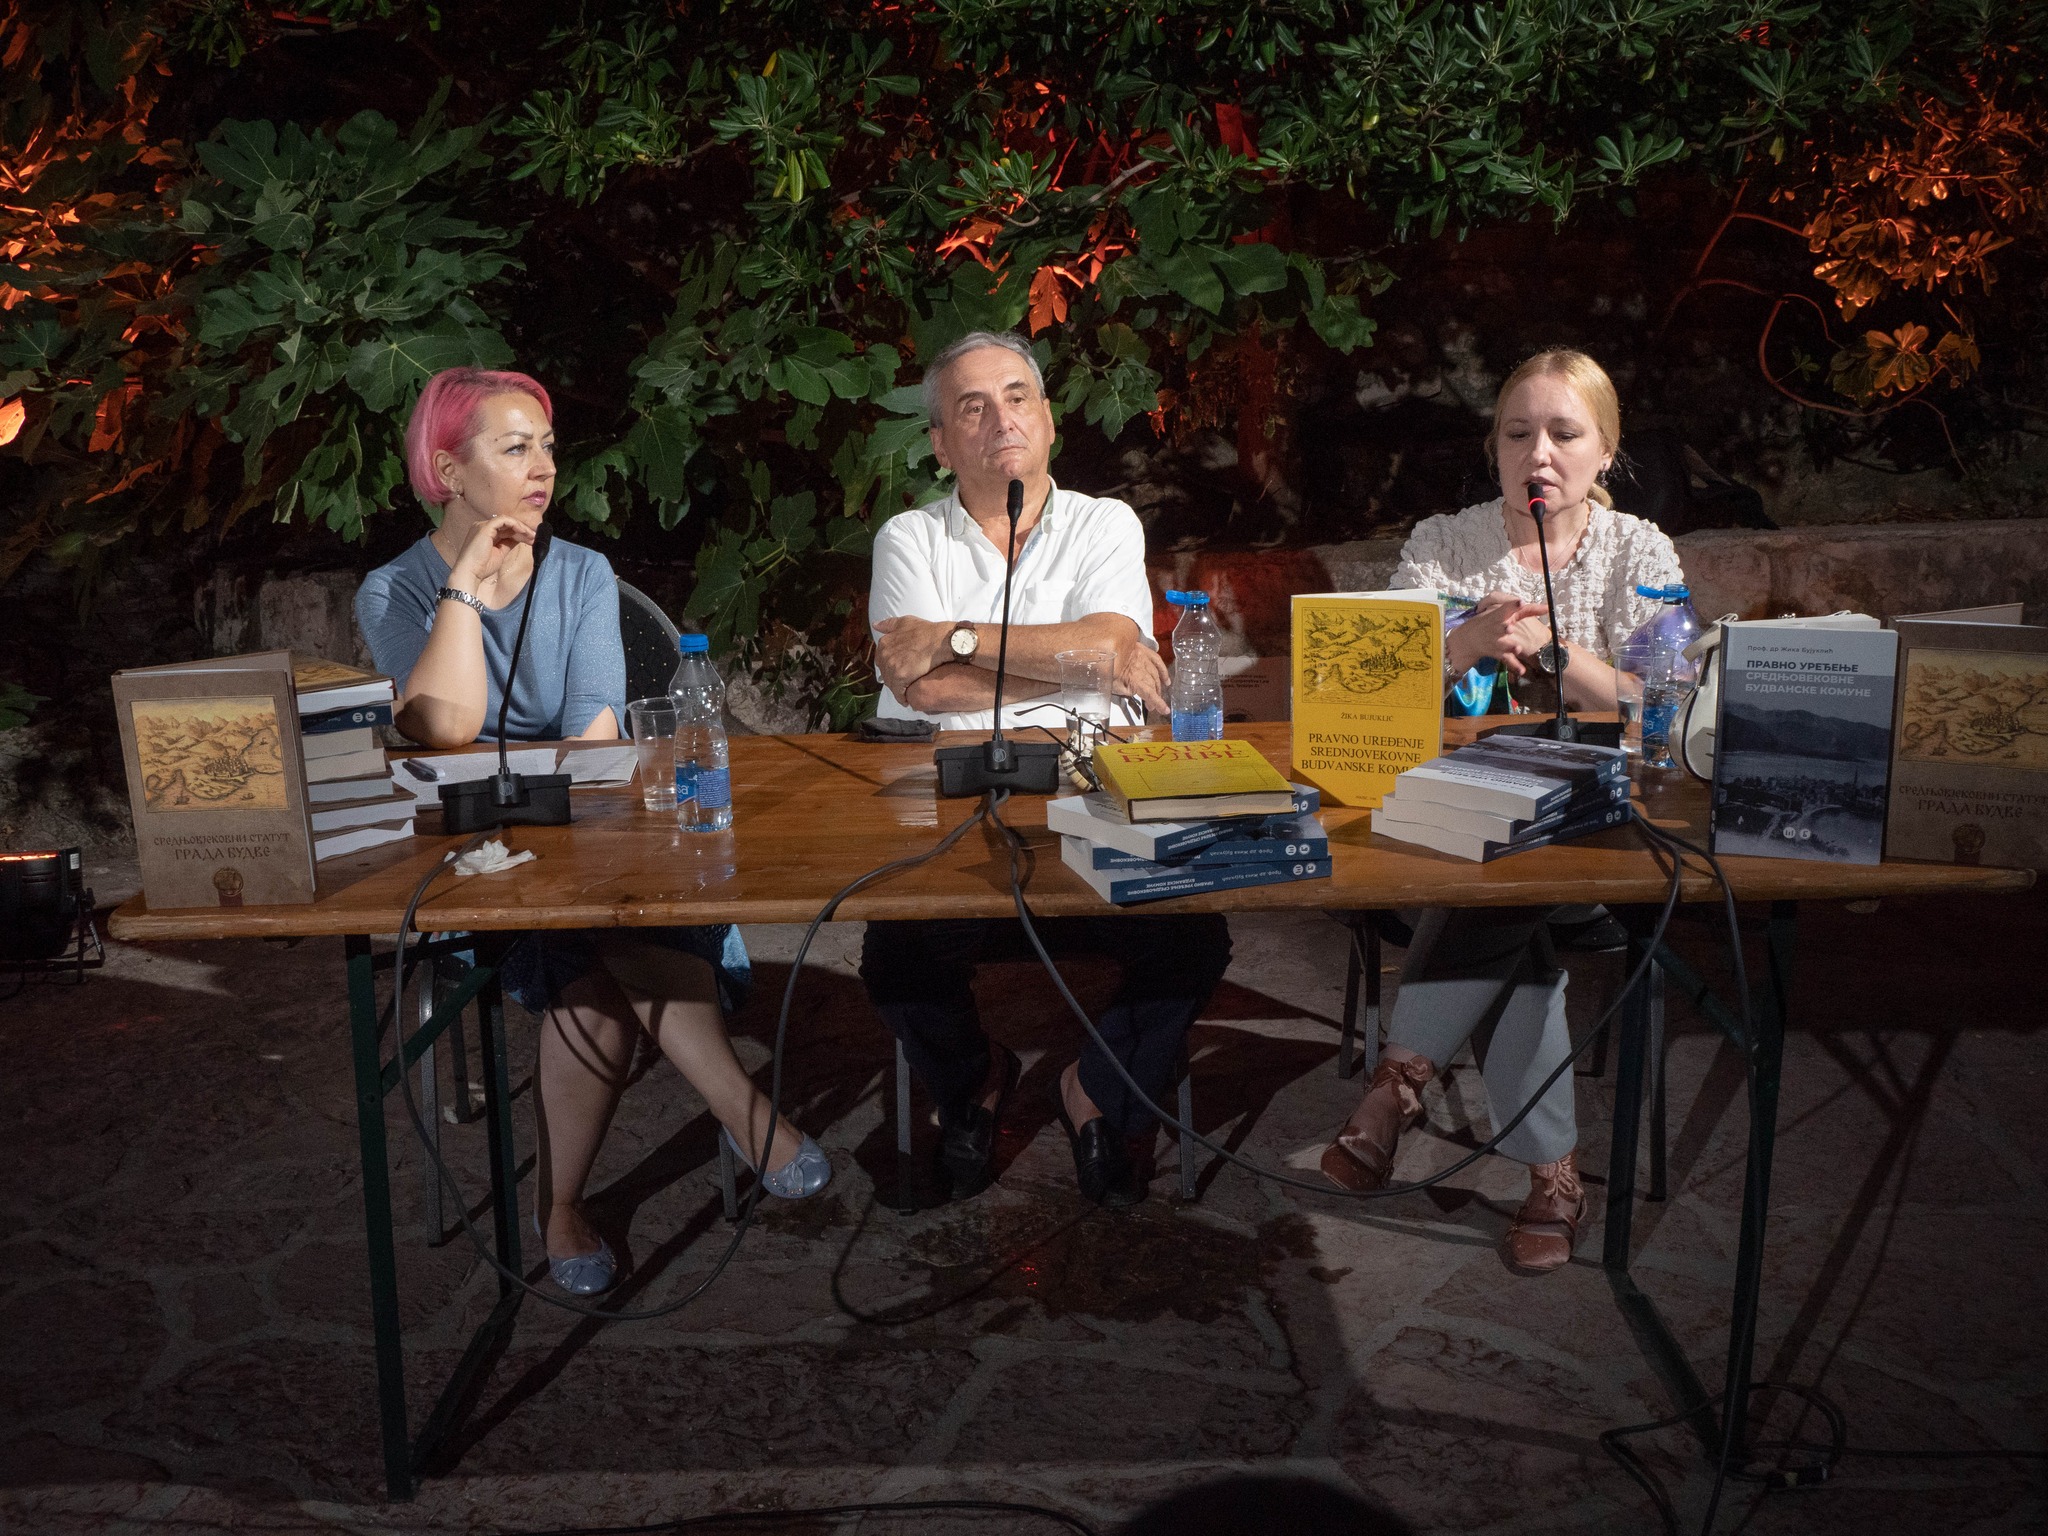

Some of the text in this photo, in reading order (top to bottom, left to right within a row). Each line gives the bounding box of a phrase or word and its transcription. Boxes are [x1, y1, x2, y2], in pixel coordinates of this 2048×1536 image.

[1746, 660, 1859, 673] ПРАВНО УРЕЂЕЊЕ
[1745, 671, 1855, 685] СРЕДЊОВЕКОВНЕ
[1744, 683, 1872, 697] БУДВАНСКЕ КОМУНЕ
[1340, 712, 1394, 722] ŽIKA BUJUKLIĆ
[1308, 732, 1425, 750] PRAVNO UREĐENJE
[1116, 742, 1238, 756] СТАТУТ
[1310, 746, 1421, 763] SREDNJOVEKOVNE
[1122, 750, 1251, 763] БУДВЕ
[1301, 759, 1375, 773] BUDVANSKE
[1918, 800, 2023, 819] ГРАДА БУДВЕ
[249, 832, 290, 843] СТАТУТ
[175, 846, 271, 861] ГРАДА БУДВЕ
